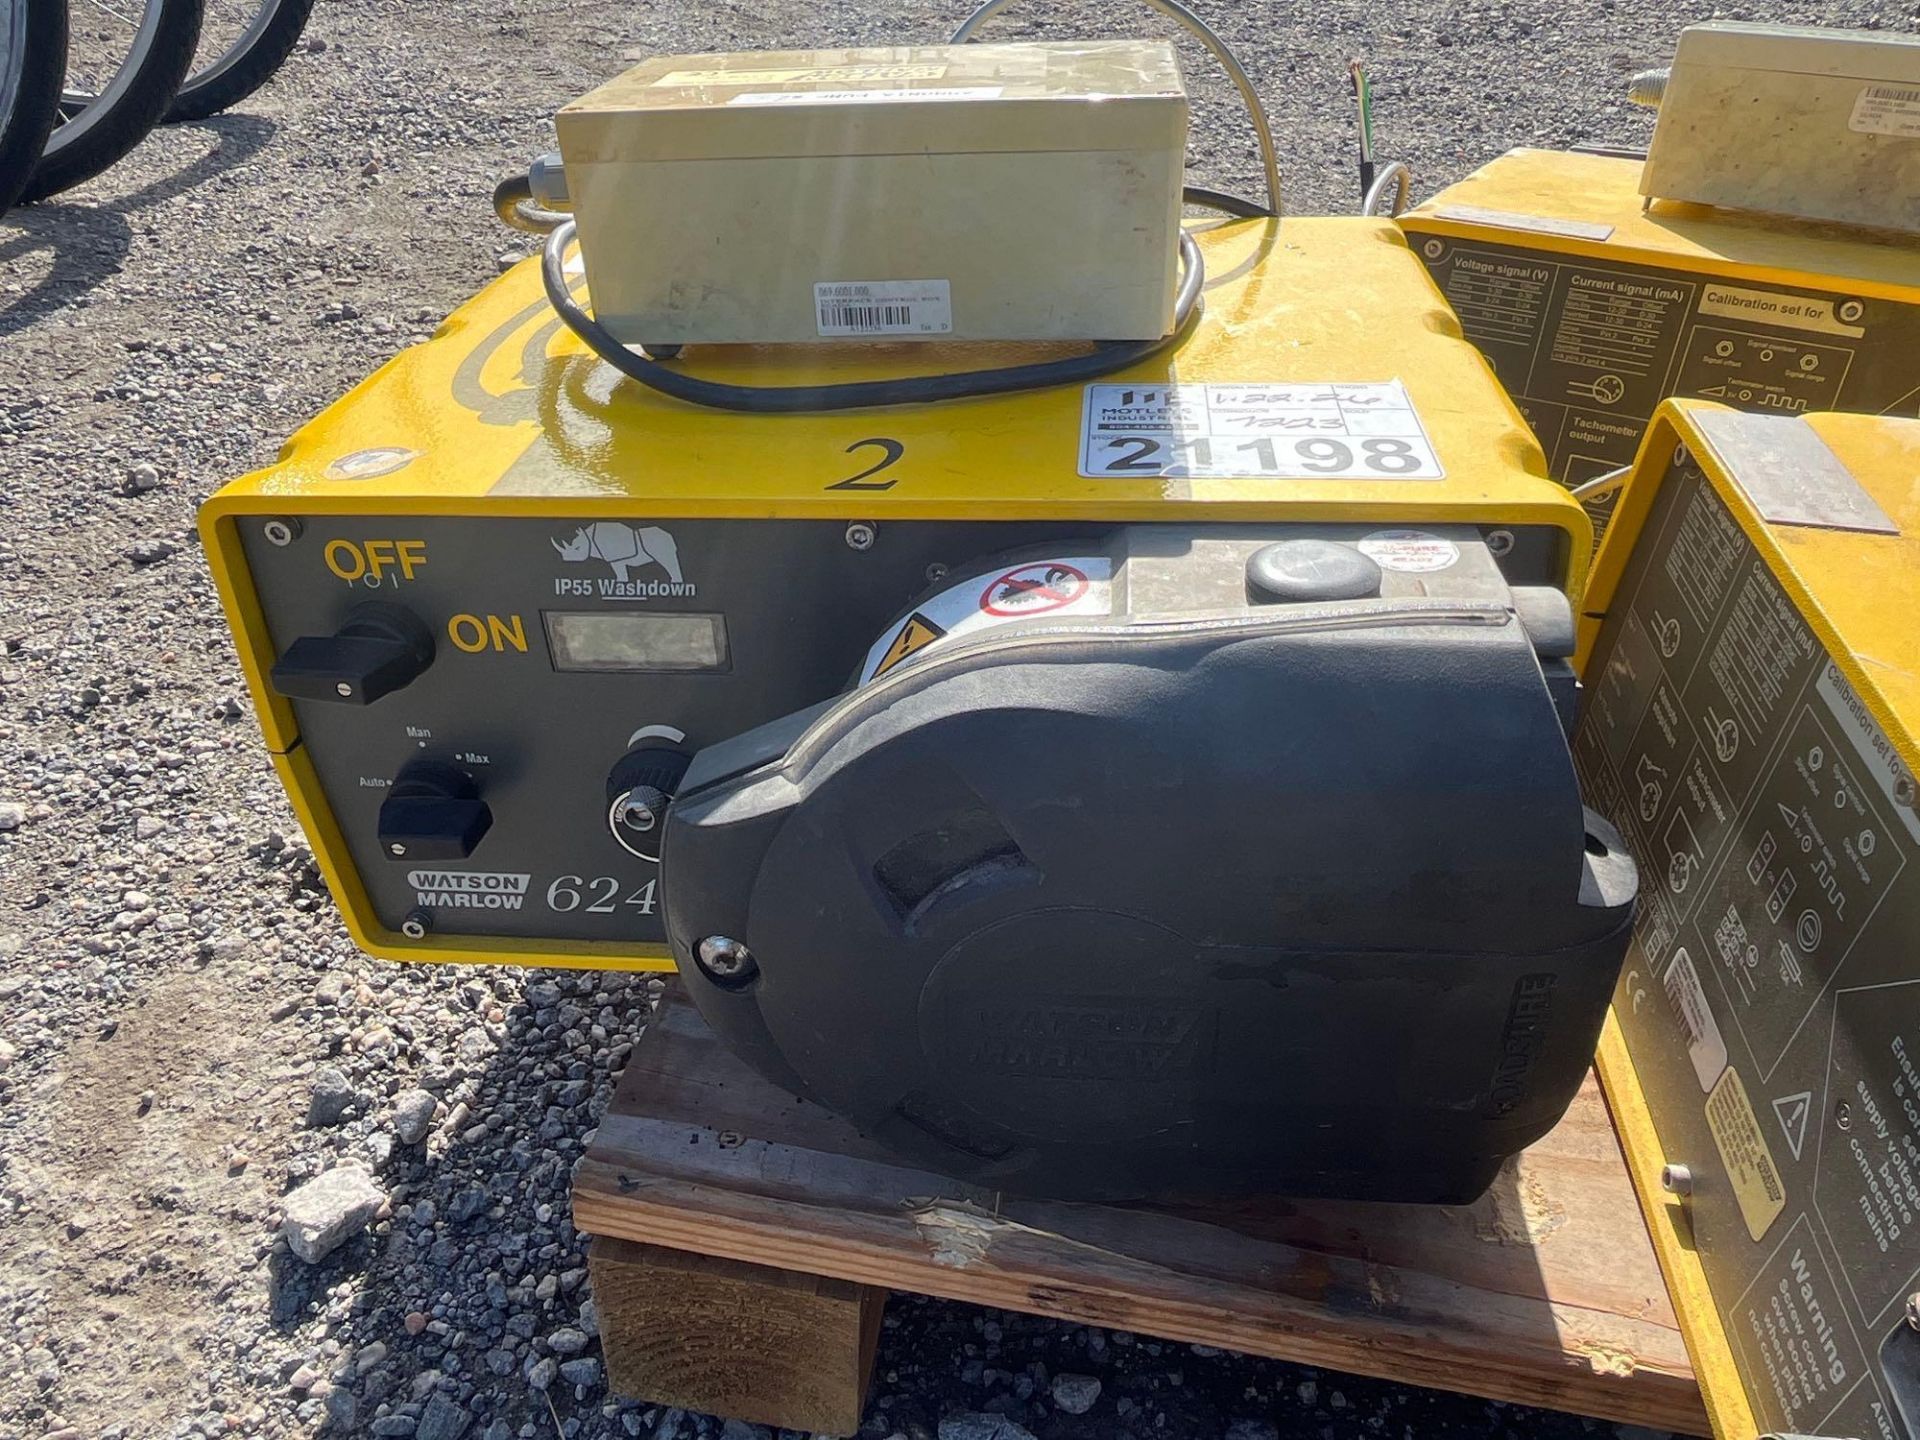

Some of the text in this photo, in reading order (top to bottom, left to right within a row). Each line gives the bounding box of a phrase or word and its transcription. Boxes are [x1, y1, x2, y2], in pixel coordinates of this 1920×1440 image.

[1454, 257, 1549, 282] Voltage signal (V)
[1571, 274, 1684, 303] Current signal (mA)
[1707, 291, 1825, 320] Calibration set for
[1569, 430, 1606, 445] output
[1573, 416, 1639, 438] Tachometer
[823, 437, 905, 491] 2
[1105, 437, 1422, 474] 21198
[323, 539, 428, 581] OFF
[554, 578, 696, 598] IP55 Washdown
[1752, 560, 1779, 602] Current
[1775, 598, 1800, 632] signal
[1795, 625, 1816, 661] (mA)
[447, 613, 529, 654] ON
[1827, 664, 1873, 736] Calibration
[1872, 734, 1891, 760] set
[405, 726, 432, 738] Man
[465, 752, 490, 764] Max
[359, 777, 386, 787] Auto
[1686, 775, 1706, 813] output
[1695, 757, 1727, 824] Tachometer
[415, 872, 520, 890] WATSON
[546, 875, 658, 915] 624
[417, 892, 524, 910] MARLOW
[1892, 1075, 1905, 1097] is
[1856, 1079, 1920, 1212] supply voltage
[1850, 1137, 1900, 1241] connecting
[1879, 1161, 1912, 1225] before
[1859, 1194, 1888, 1253] mains
[1748, 1307, 1764, 1340] not
[1779, 1277, 1828, 1392] Screw cover
[1790, 1248, 1846, 1386] Warning
[1763, 1312, 1802, 1410] when plug
[1770, 1295, 1816, 1404] over socket
